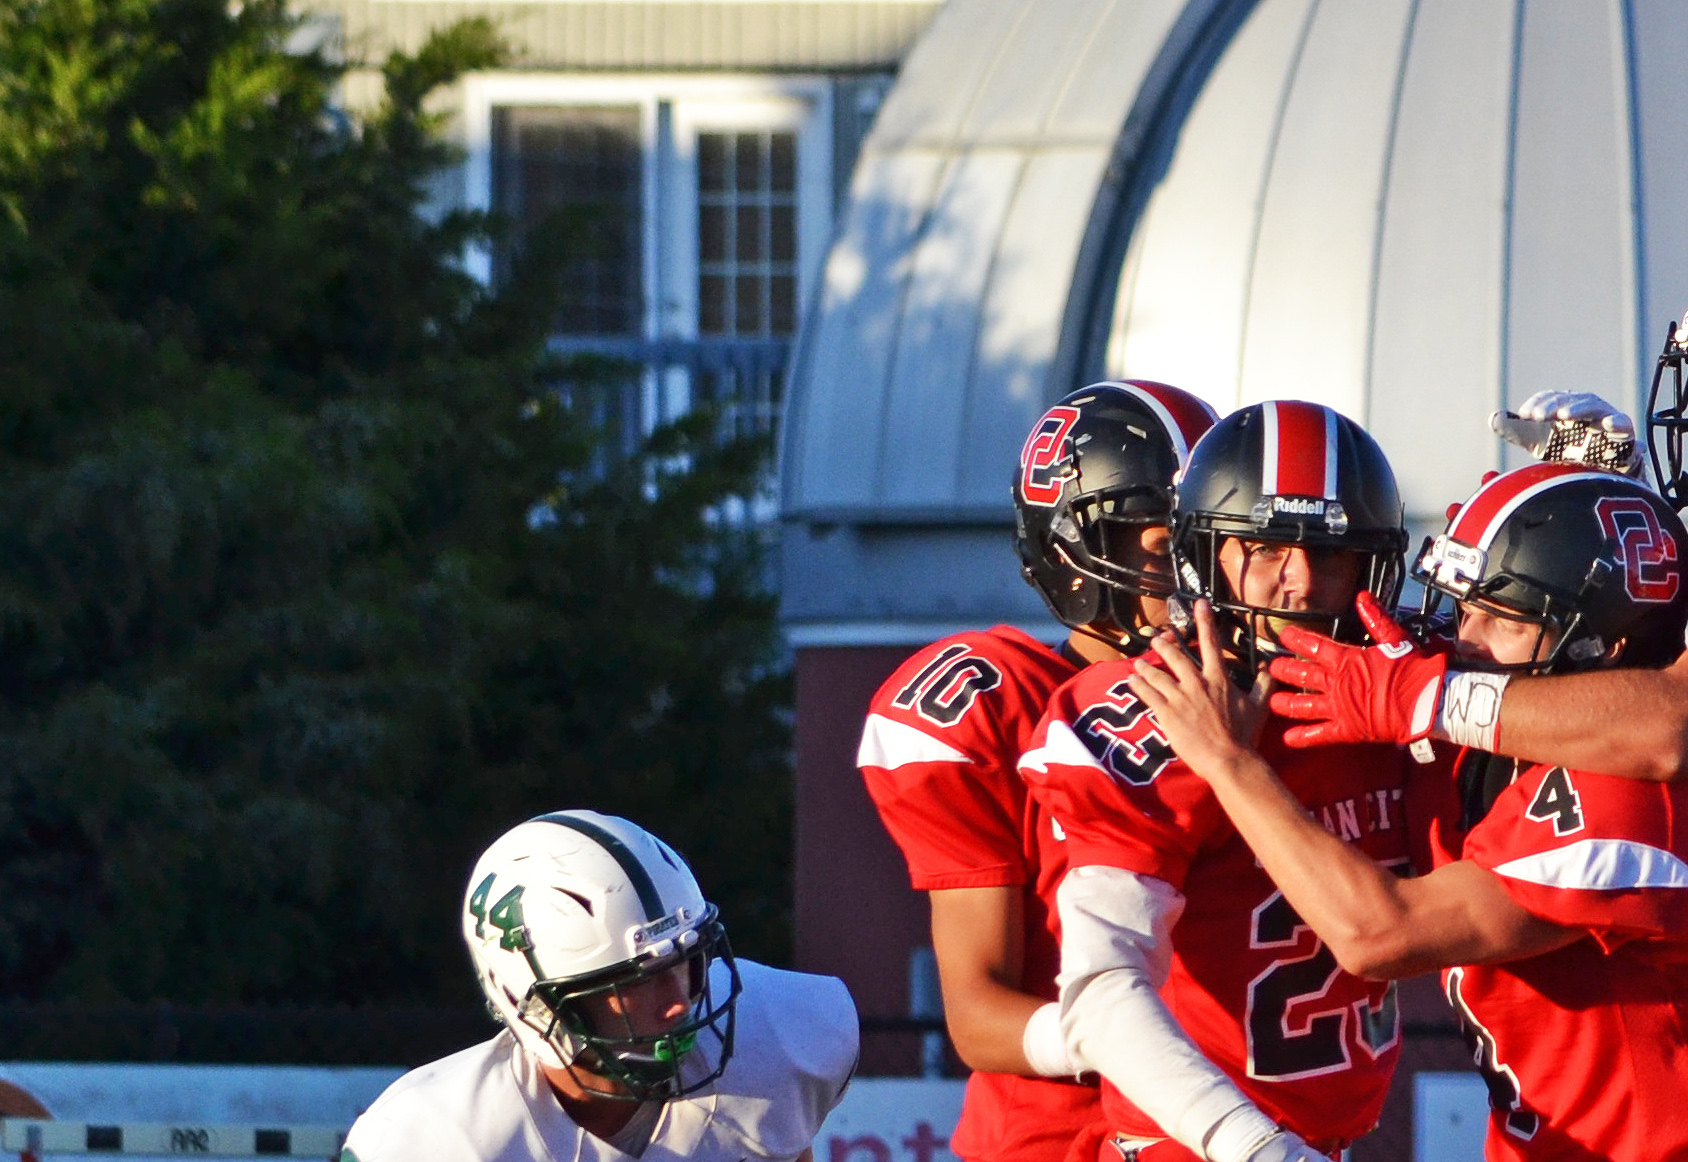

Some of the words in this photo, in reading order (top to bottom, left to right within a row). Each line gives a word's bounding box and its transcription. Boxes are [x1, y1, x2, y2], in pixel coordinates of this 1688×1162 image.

[1273, 496, 1324, 515] Riddell
[892, 644, 1002, 728] 10
[1072, 680, 1178, 787] 23
[1524, 766, 1585, 837] 4
[469, 871, 527, 954] 44
